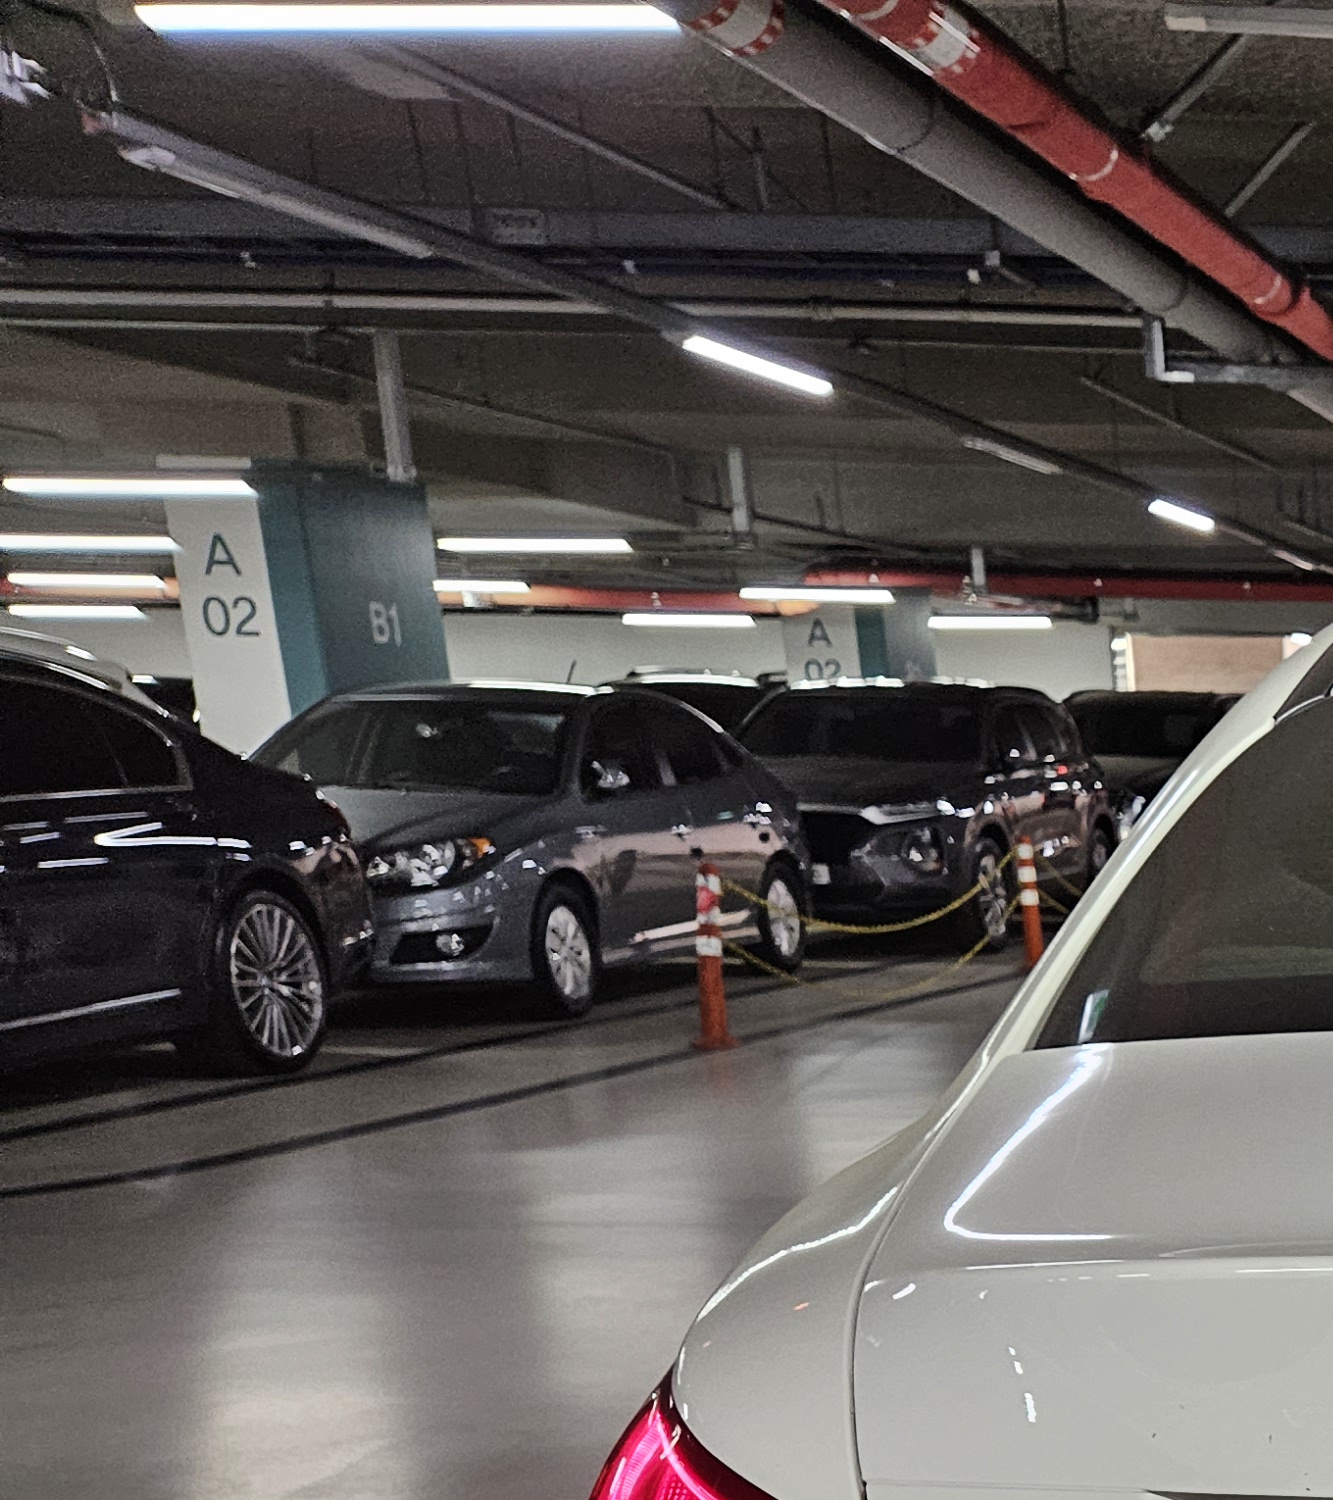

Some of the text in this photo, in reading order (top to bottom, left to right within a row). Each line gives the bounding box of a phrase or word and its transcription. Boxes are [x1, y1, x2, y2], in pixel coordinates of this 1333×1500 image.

[205, 532, 242, 576] A
[202, 596, 260, 636] 02
[369, 601, 402, 647] B1
[807, 617, 833, 647] A
